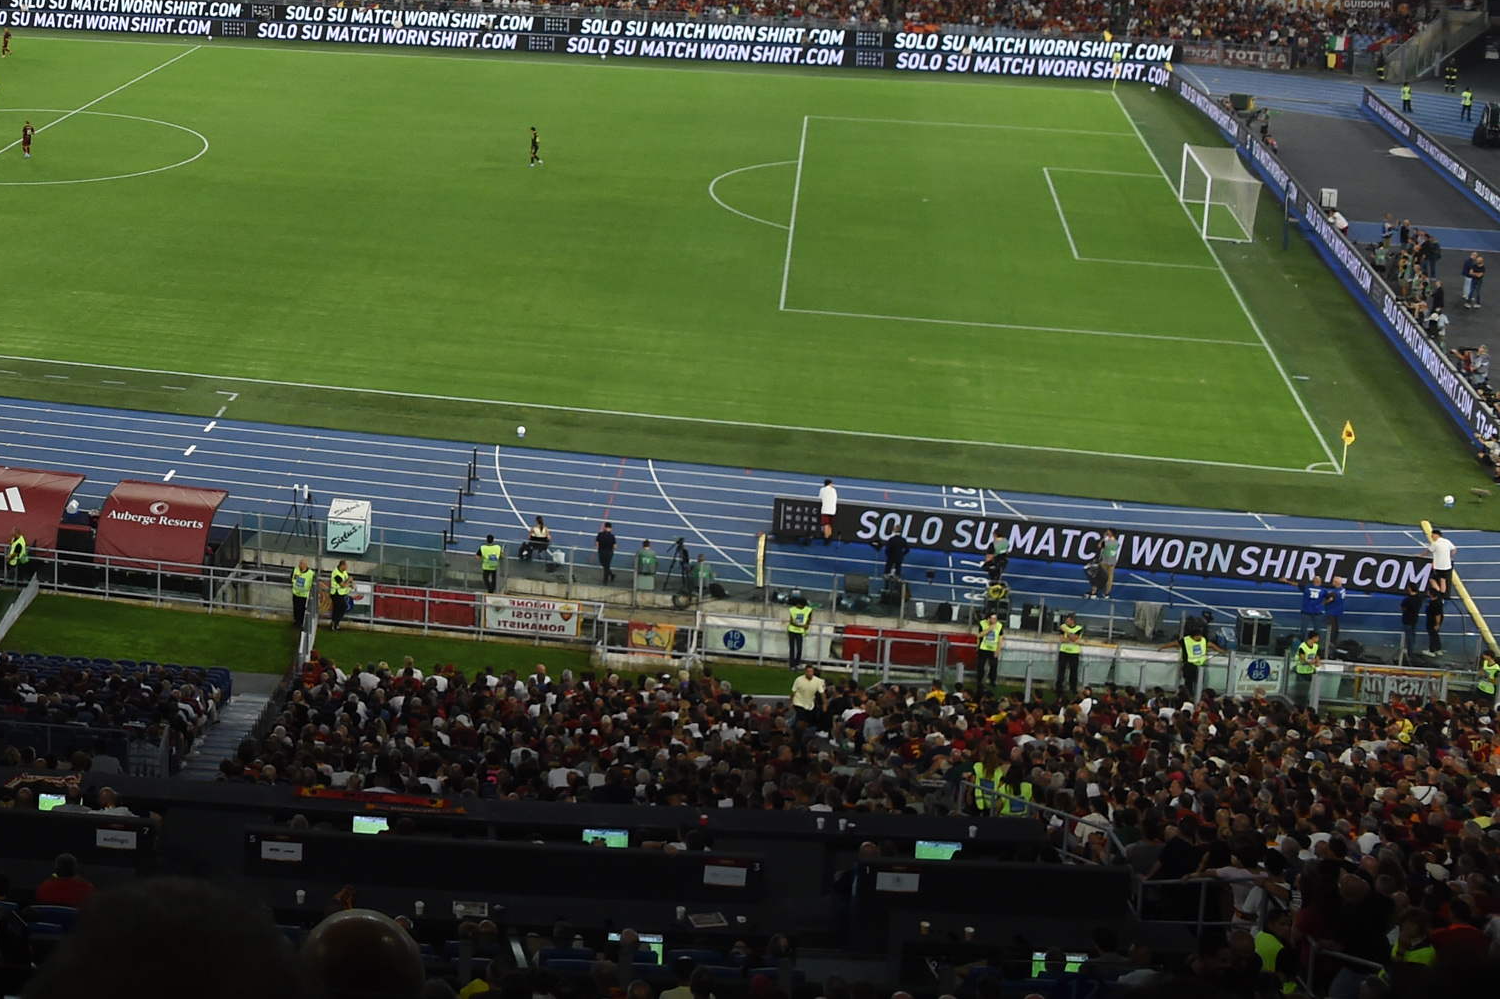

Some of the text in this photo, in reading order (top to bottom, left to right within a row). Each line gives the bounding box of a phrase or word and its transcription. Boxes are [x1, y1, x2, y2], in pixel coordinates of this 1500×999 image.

[1344, 0, 1390, 9] GUIDONIA
[11, 12, 30, 26] SU
[286, 6, 321, 21] SOLO
[327, 8, 347, 22] SU
[258, 23, 297, 38] SOLO
[301, 25, 322, 40] SU
[581, 19, 621, 35] SOLO
[625, 20, 647, 36] SU
[566, 38, 609, 54] SOLO
[614, 39, 636, 55] SU
[894, 33, 938, 50] SOLO
[942, 34, 965, 51] SU
[896, 53, 941, 70] SOLO
[946, 54, 970, 72] SU
[1383, 294, 1397, 325] SOLO
[1396, 311, 1405, 333] SU
[952, 486, 977, 495] 2
[785, 505, 818, 515] MATC
[954, 500, 978, 508] 3
[107, 509, 204, 530] Auberge Resorts
[330, 525, 357, 549] Sixtus
[857, 511, 943, 545] SOLO
[952, 519, 997, 551] SU
[728, 631, 740, 640] 10
[727, 640, 740, 649] BC
[1254, 660, 1266, 669] 10
[143, 827, 150, 835] 7
[249, 834, 256, 843] 5
[753, 863, 760, 872] 3
